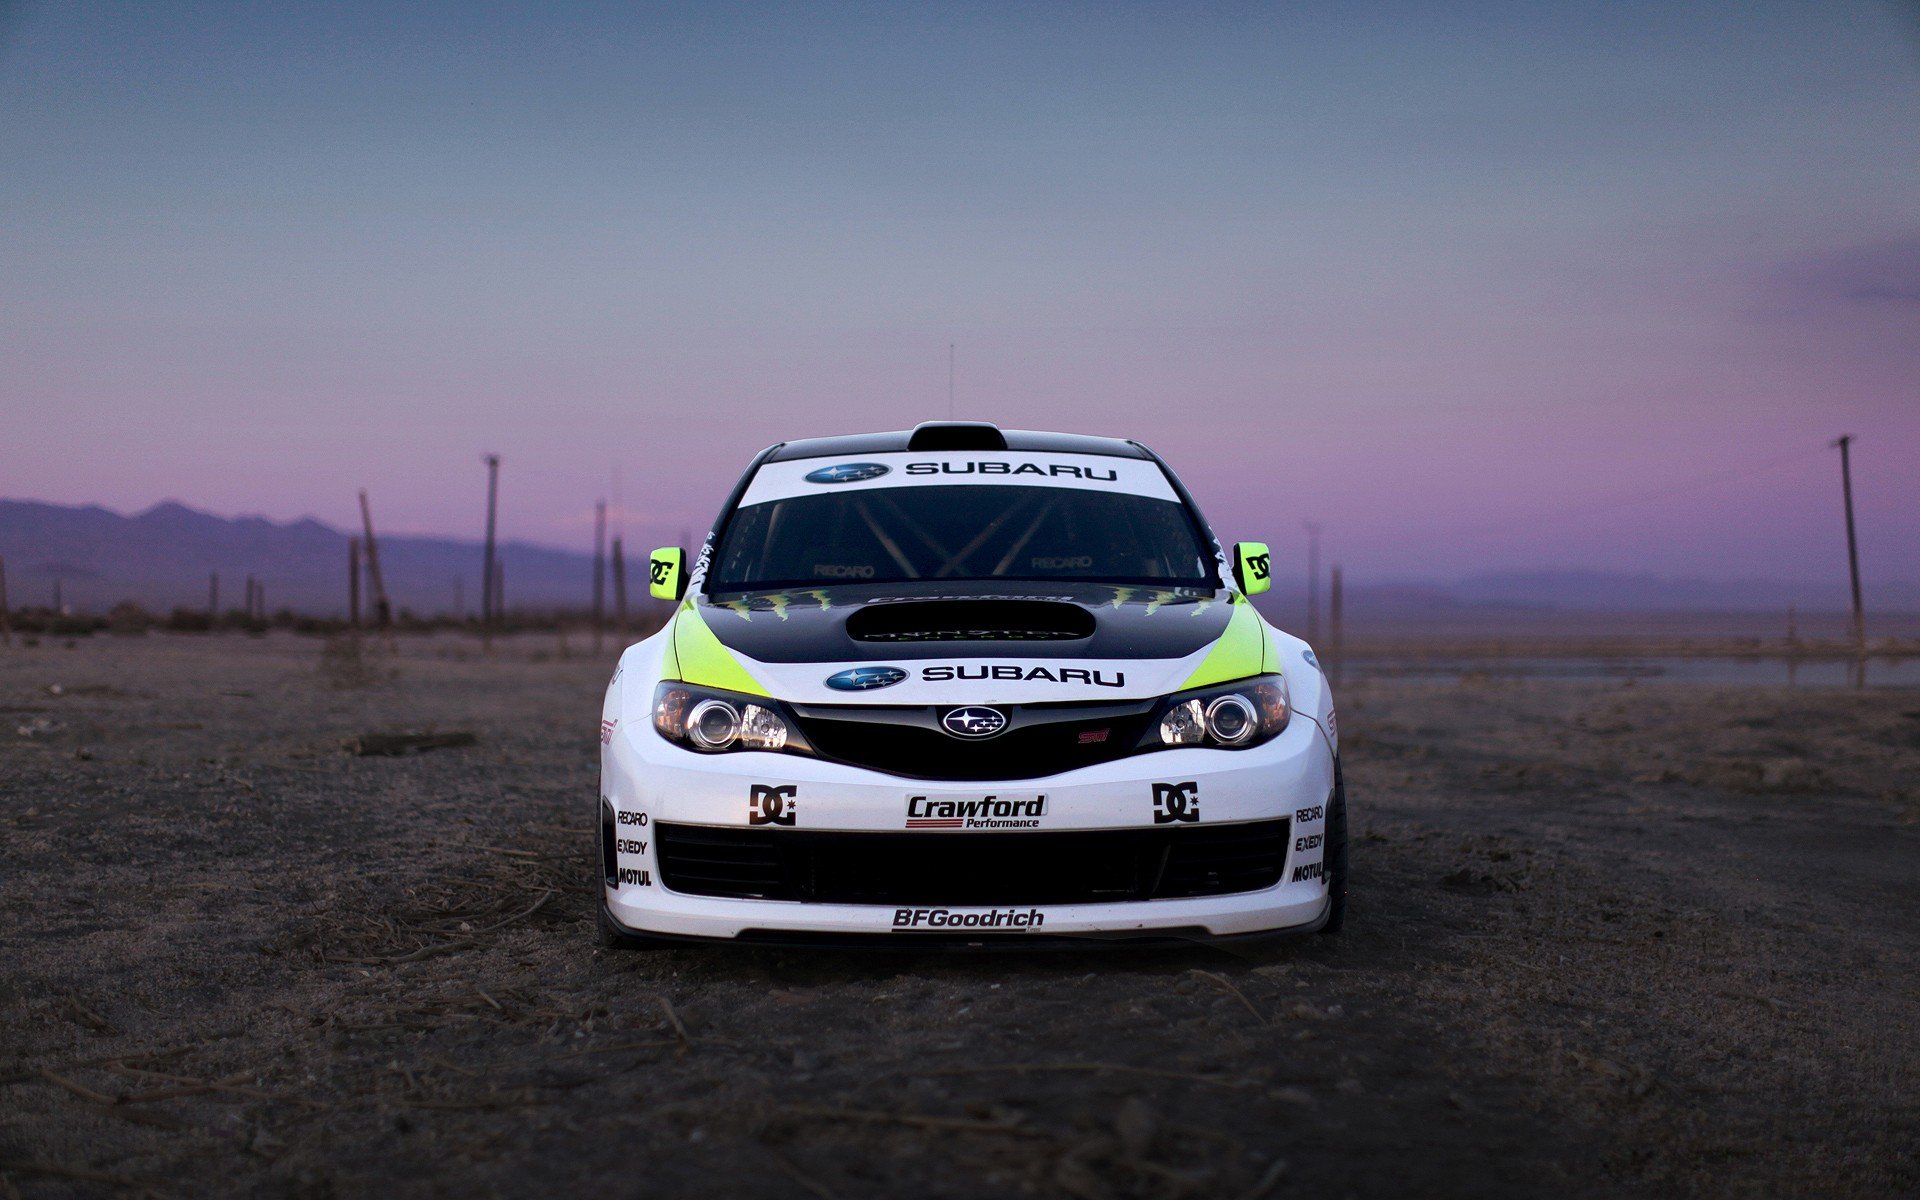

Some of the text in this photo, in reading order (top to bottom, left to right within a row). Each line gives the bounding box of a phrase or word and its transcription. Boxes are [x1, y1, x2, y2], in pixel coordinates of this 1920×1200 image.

[906, 462, 1117, 482] SUBARU
[814, 563, 874, 578] RECARO
[1031, 555, 1092, 570] RECARO
[922, 665, 1125, 688] SUBARU
[749, 784, 797, 826] DC
[907, 795, 1045, 818] Crawford
[1151, 781, 1200, 824] DC
[617, 810, 648, 826] RECARO
[966, 818, 1040, 828] Performance
[1296, 805, 1323, 823] RECARO
[617, 839, 648, 855] EXEDY
[1295, 833, 1323, 852] EXEDY
[619, 868, 652, 886] MOTUL
[1292, 862, 1322, 882] MOTUL
[893, 909, 1044, 927] BFGoodrich
